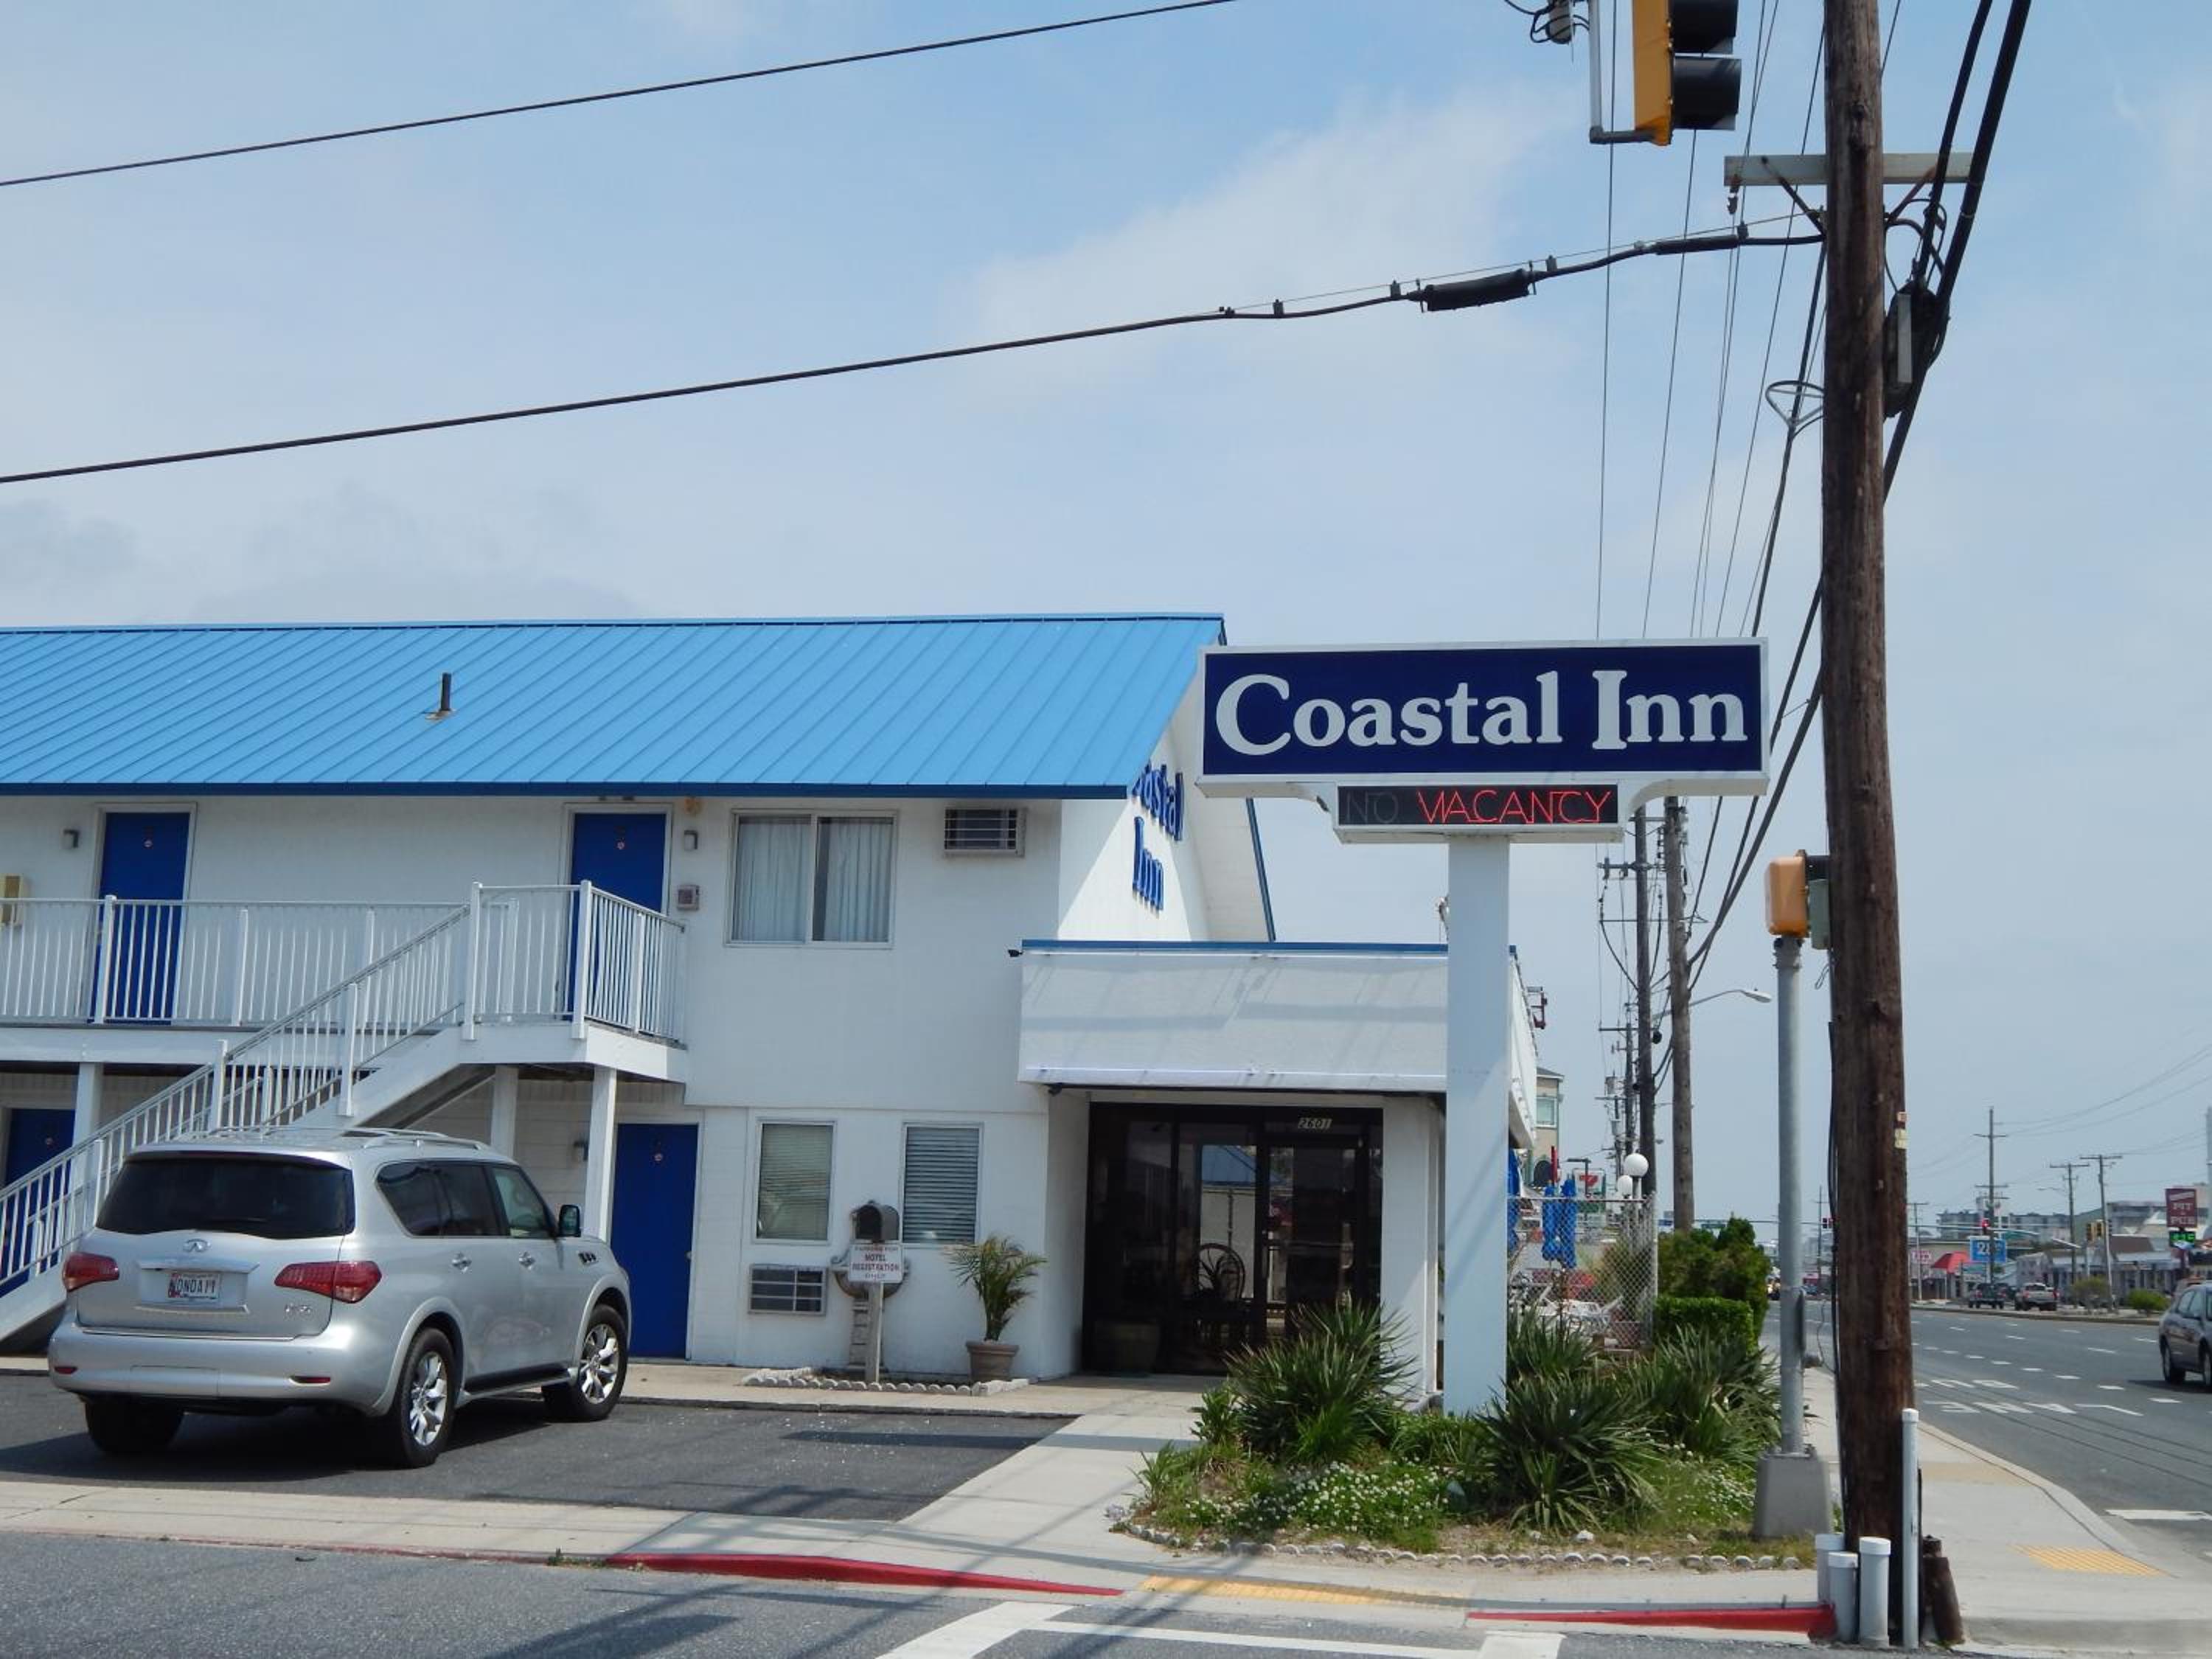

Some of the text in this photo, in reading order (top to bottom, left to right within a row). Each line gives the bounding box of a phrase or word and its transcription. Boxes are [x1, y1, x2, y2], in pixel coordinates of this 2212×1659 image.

[1216, 669, 1748, 756] Coastal Inn
[1346, 790, 1612, 824] NO VACANCY
[1133, 816, 1164, 911] Inn
[865, 1253, 886, 1262] MOTEL
